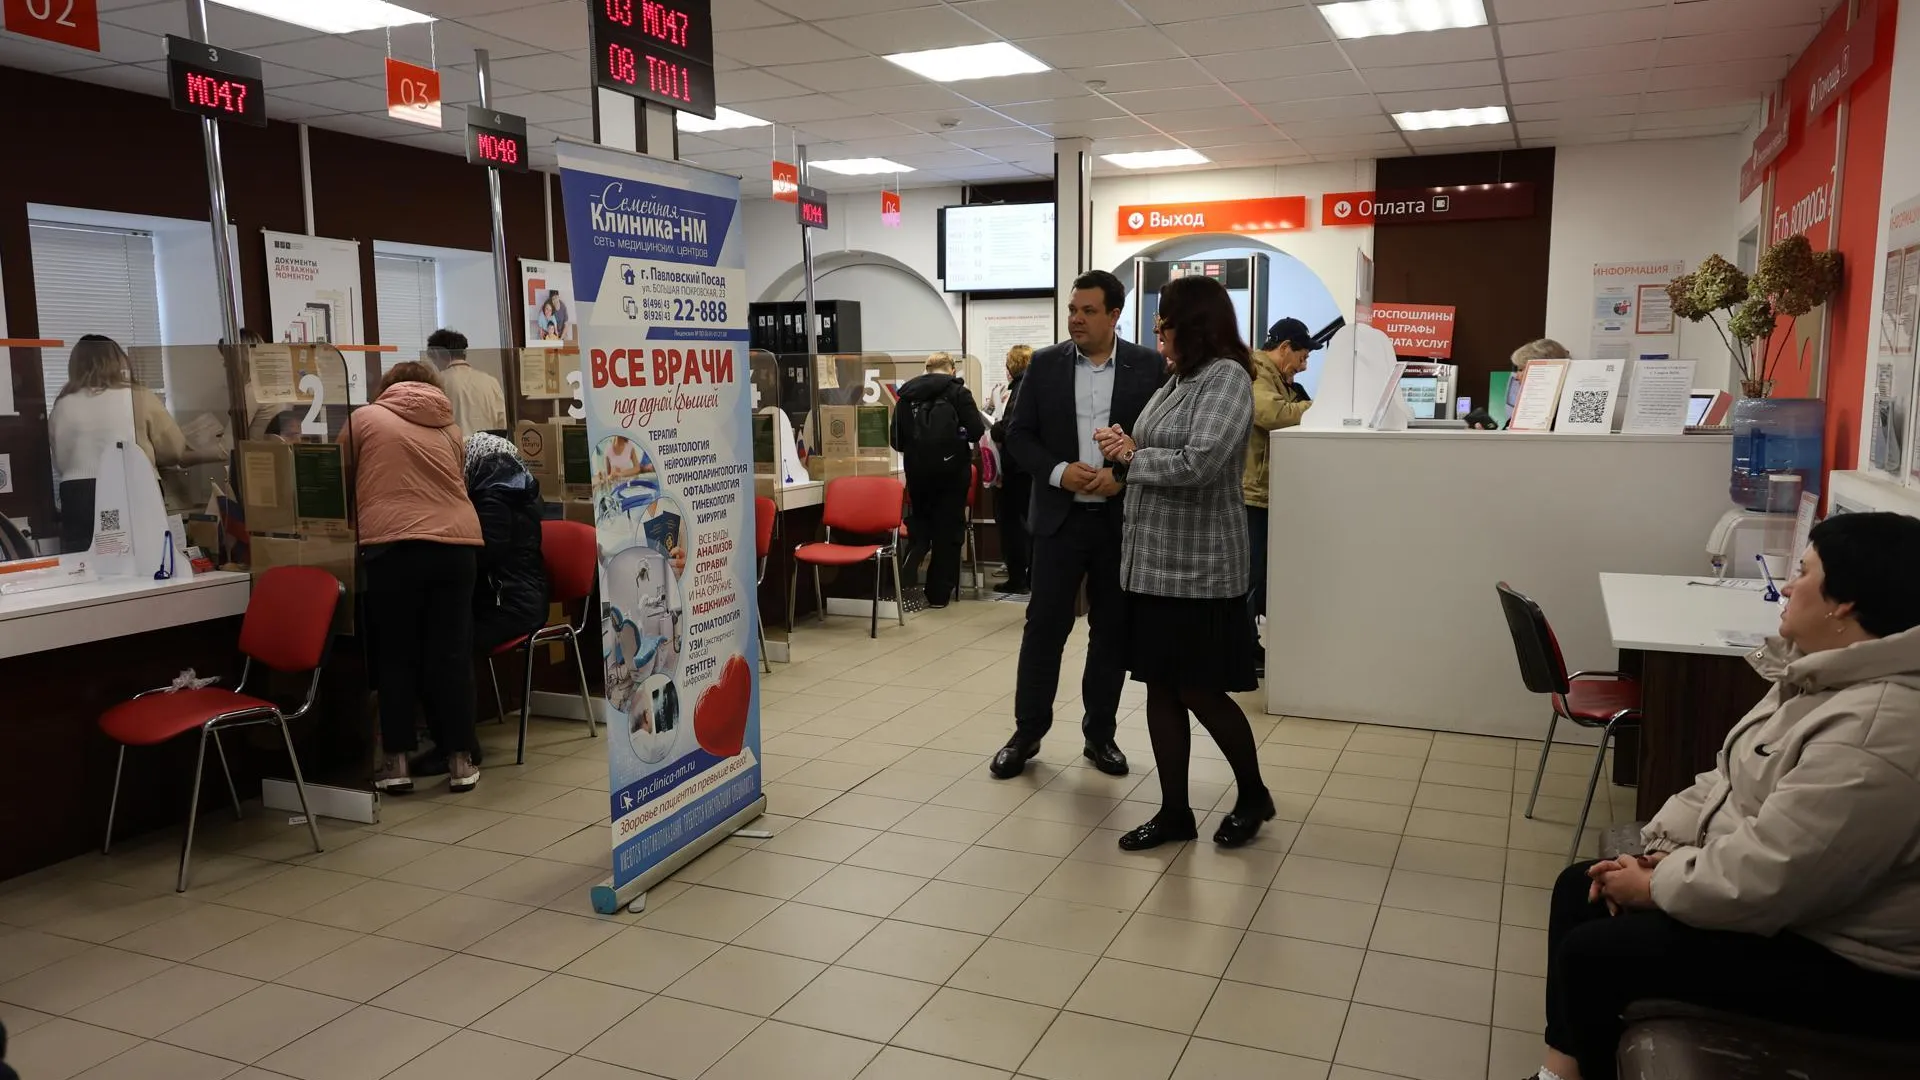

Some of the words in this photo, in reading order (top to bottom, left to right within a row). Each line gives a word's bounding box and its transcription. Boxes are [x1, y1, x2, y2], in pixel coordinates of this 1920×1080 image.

[208, 48, 219, 62] 3
[609, 43, 635, 84] 08
[400, 78, 430, 110] 03
[494, 114, 501, 125] 4
[601, 181, 680, 219] Семейная
[1358, 199, 1426, 216] Оплата
[590, 201, 708, 245] Клиника-НМ
[1149, 211, 1205, 228] Выход
[593, 235, 615, 248] сеть
[617, 239, 675, 255] медицинских
[677, 246, 709, 260] центров
[274, 256, 318, 267] ДОКУМЕНТЫ
[275, 264, 290, 272] ДЛЯ
[290, 266, 319, 275] ВАЖНЫХ
[1593, 264, 1669, 276] ИНФОРМАЦИЯ
[275, 272, 314, 281] МОМЕНТОВ
[641, 269, 649, 280] г.
[650, 266, 700, 284] Павловский
[701, 272, 726, 288] Посад
[652, 284, 680, 295] БОЛЬШАЯ
[719, 289, 726, 298] 23
[663, 300, 670, 309] 43
[673, 298, 728, 322] 22-888
[664, 311, 671, 321] 43
[1372, 309, 1453, 321] ГОСПОШЛИНЫ
[1386, 323, 1436, 335] ШТРАФЫ
[1415, 339, 1450, 349] УСЛУГ
[590, 348, 646, 389] ВСЕ
[651, 348, 734, 386] ВРАЧИ
[566, 370, 586, 419] 3
[862, 368, 880, 403] 5
[299, 374, 328, 435] 2
[613, 397, 636, 429] под
[638, 388, 672, 428] одной
[673, 382, 719, 424] крышей
[648, 428, 678, 441] ТЕРАПИЯ
[658, 439, 710, 456] РЕВМАТОЛОГИЯ
[664, 453, 717, 471] НЕЙРОХИРУРГИЯ
[666, 463, 748, 485] ОТОРИНОЛАРИНГОЛОГИЯ
[683, 478, 740, 497] ОФТАЛЬМОЛОГИЯ
[691, 492, 736, 511] ГИНЕКОЛОГИЯ
[696, 508, 727, 525] ХИРУРГИЯ
[698, 532, 712, 545] ВСЕ
[712, 528, 729, 541] ВИДЫ
[696, 539, 733, 559] АНАЛИЗОВ
[695, 556, 728, 574] СПРАВКИ
[694, 576, 700, 588] В
[700, 570, 723, 586] ГИБДД
[688, 591, 695, 602] И
[695, 588, 706, 599] НА
[706, 580, 733, 597] ОРУЖИЕ
[691, 592, 736, 616] МЕДКНИЖКИ
[689, 608, 741, 636] СТОМАТОЛОГИЯ
[688, 637, 704, 652] УЗИ
[688, 646, 709, 660] класса)
[685, 655, 717, 677] РЕНТГЕН
[636, 760, 697, 803] pp.clinica-nm.ru
[620, 806, 659, 836] Здоровье
[659, 785, 698, 814] пациента
[697, 766, 730, 792] превыше
[729, 755, 747, 774] всего!
